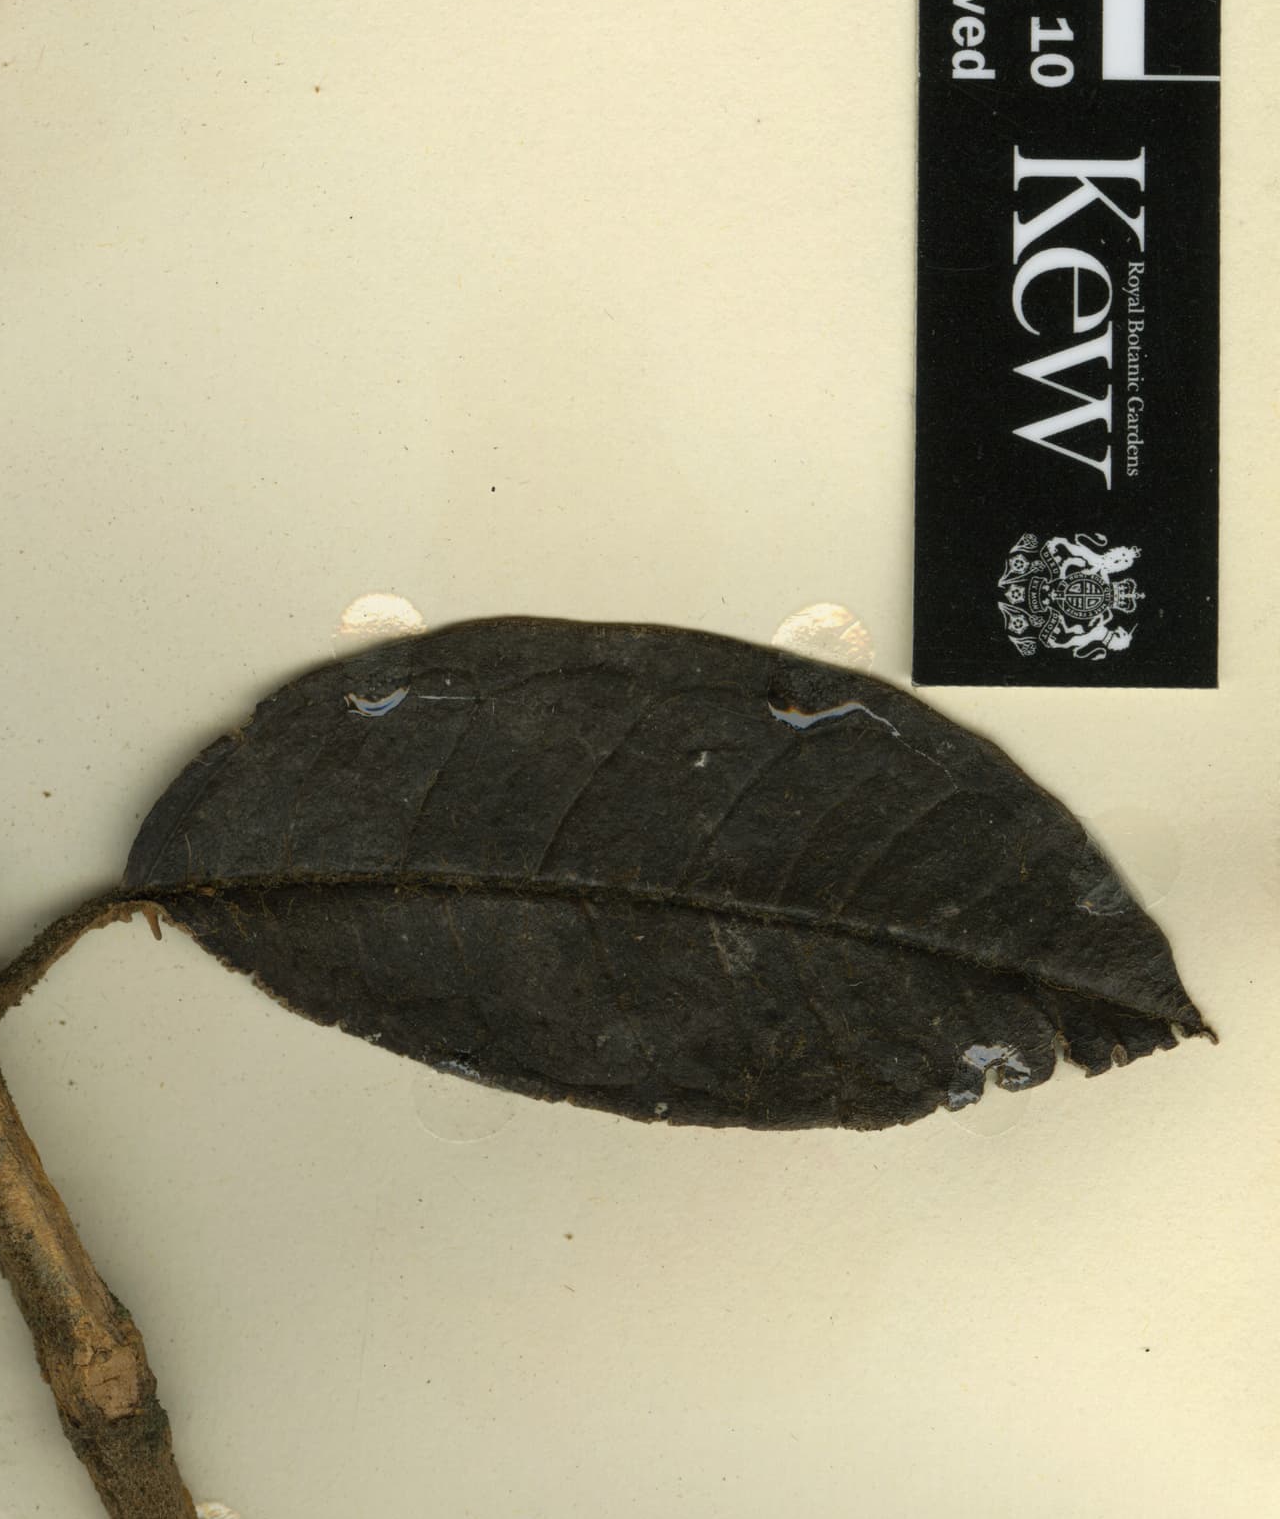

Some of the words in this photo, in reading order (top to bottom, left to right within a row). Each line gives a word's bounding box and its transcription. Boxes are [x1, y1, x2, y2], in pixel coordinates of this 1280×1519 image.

[1029, 16, 1075, 88] 10
[1010, 144, 1146, 491] Kew
[1126, 260, 1146, 315] Royal
[1126, 320, 1146, 390] Botanic
[1125, 395, 1146, 478] Gardens
